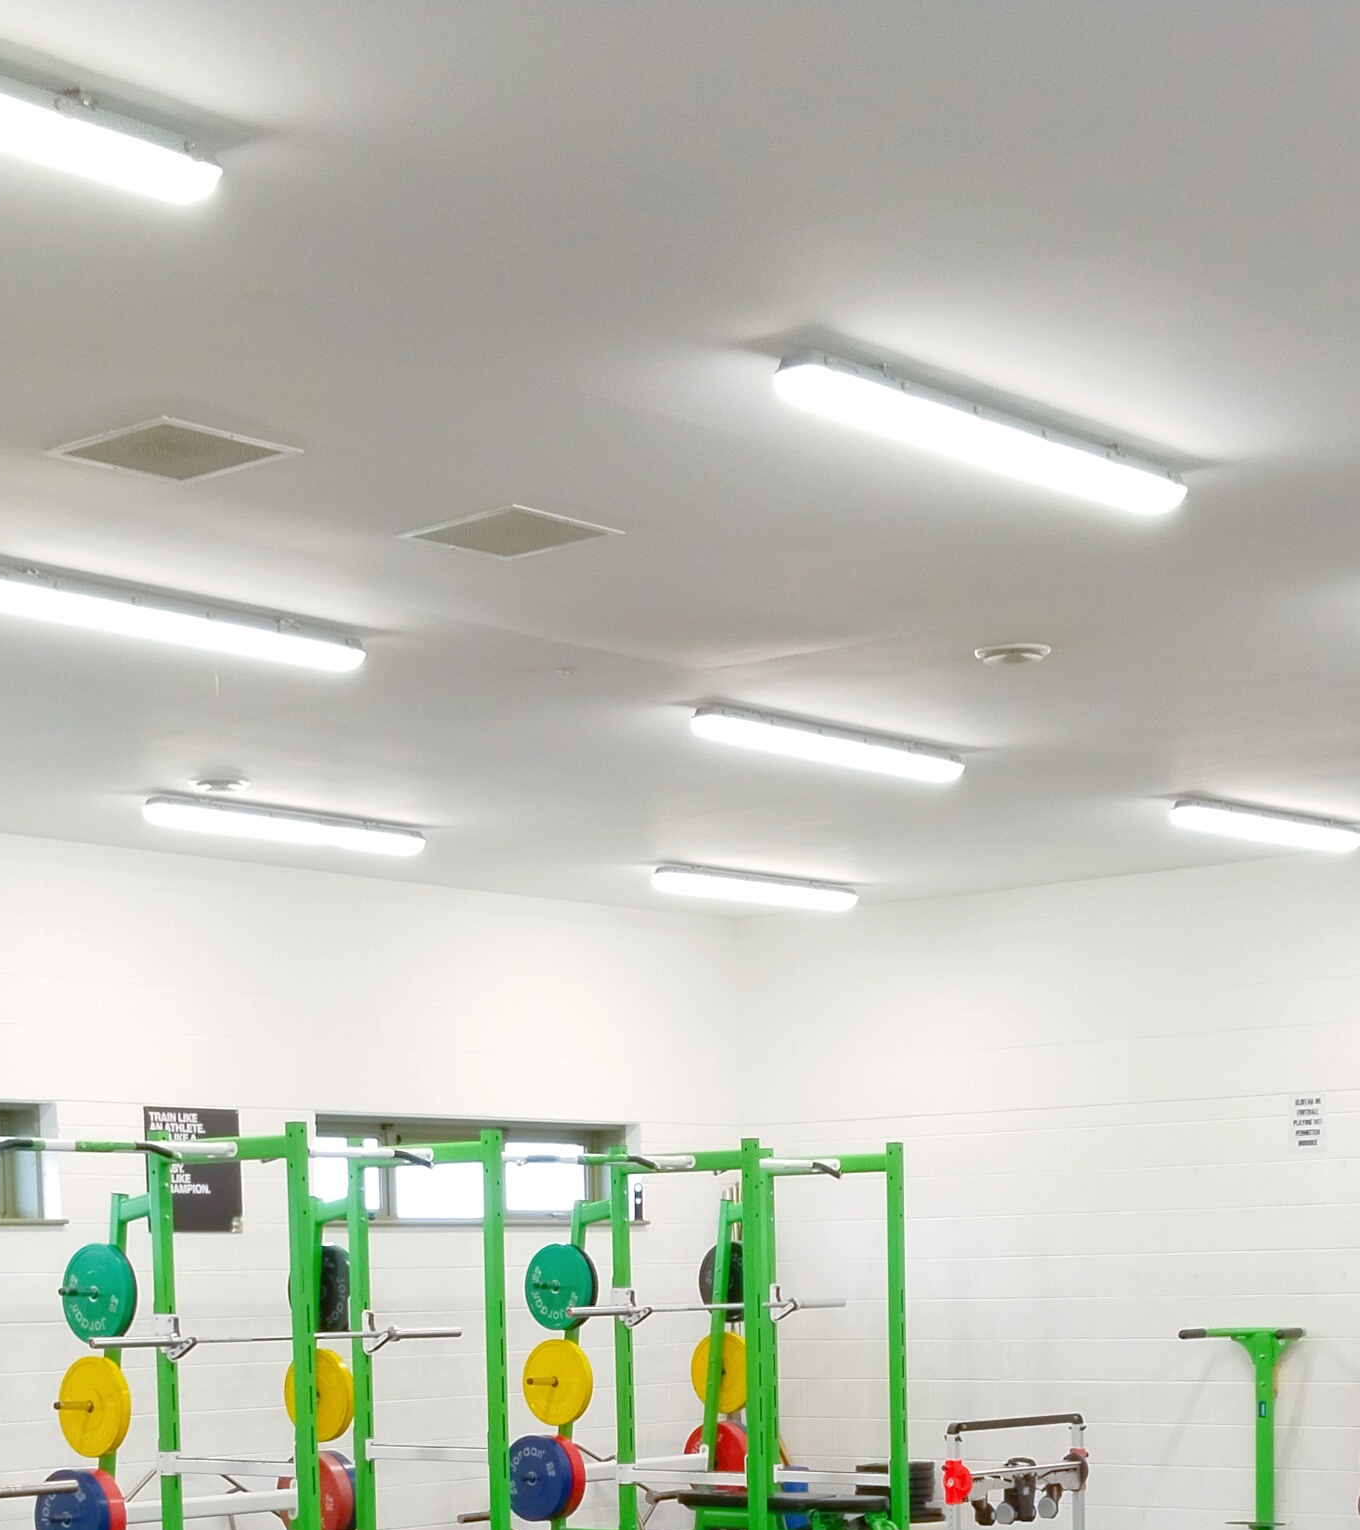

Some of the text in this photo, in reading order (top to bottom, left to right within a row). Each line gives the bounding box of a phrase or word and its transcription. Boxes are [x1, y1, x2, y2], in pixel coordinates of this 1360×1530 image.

[149, 1111, 198, 1124] TRAIN LIKE
[150, 1122, 206, 1134] AN ATHLETE.
[171, 1174, 191, 1183] LIKE
[171, 1184, 211, 1194] AMPION.
[531, 1291, 565, 1321] Jordan
[70, 1303, 107, 1331] Jordan
[510, 1446, 545, 1472] Jordan
